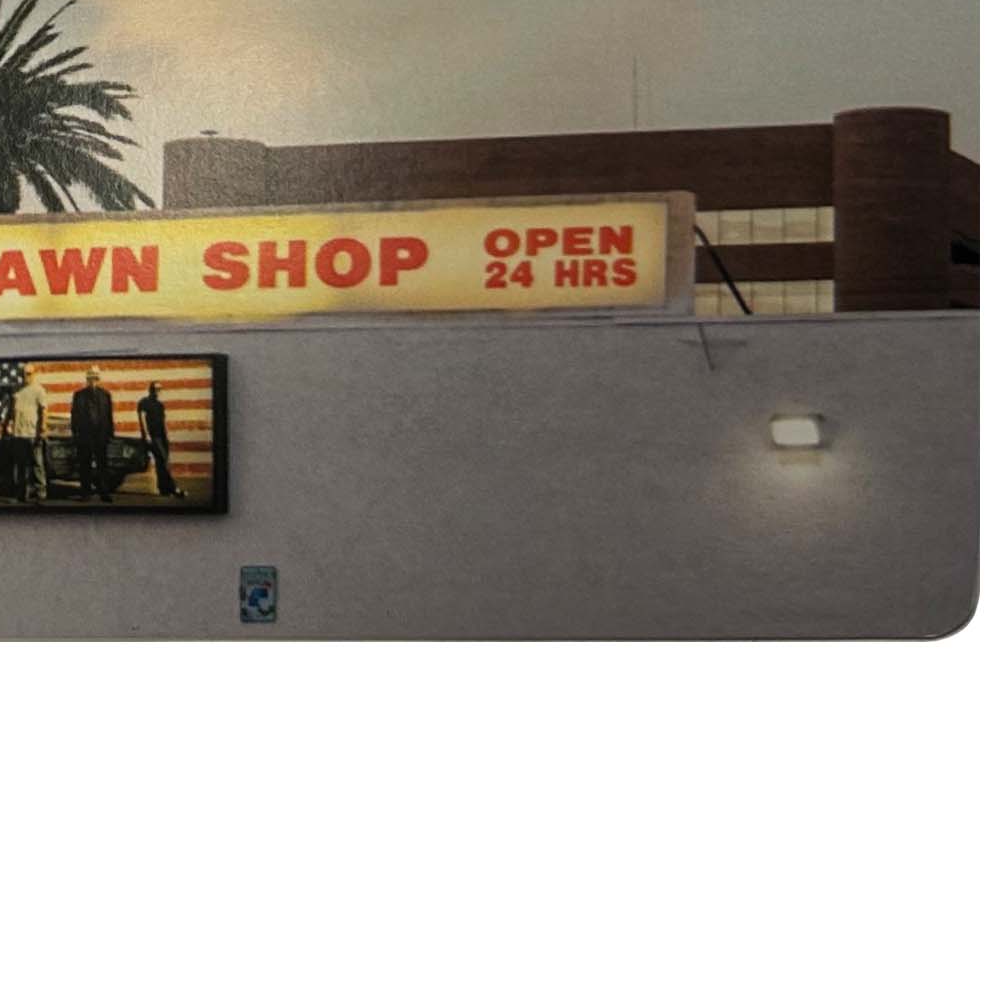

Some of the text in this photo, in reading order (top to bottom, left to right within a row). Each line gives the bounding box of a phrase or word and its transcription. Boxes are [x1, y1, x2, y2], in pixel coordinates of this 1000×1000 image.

[484, 225, 635, 258] OPEN
[202, 236, 430, 291] SHOP
[485, 258, 638, 289] 24 HRS
